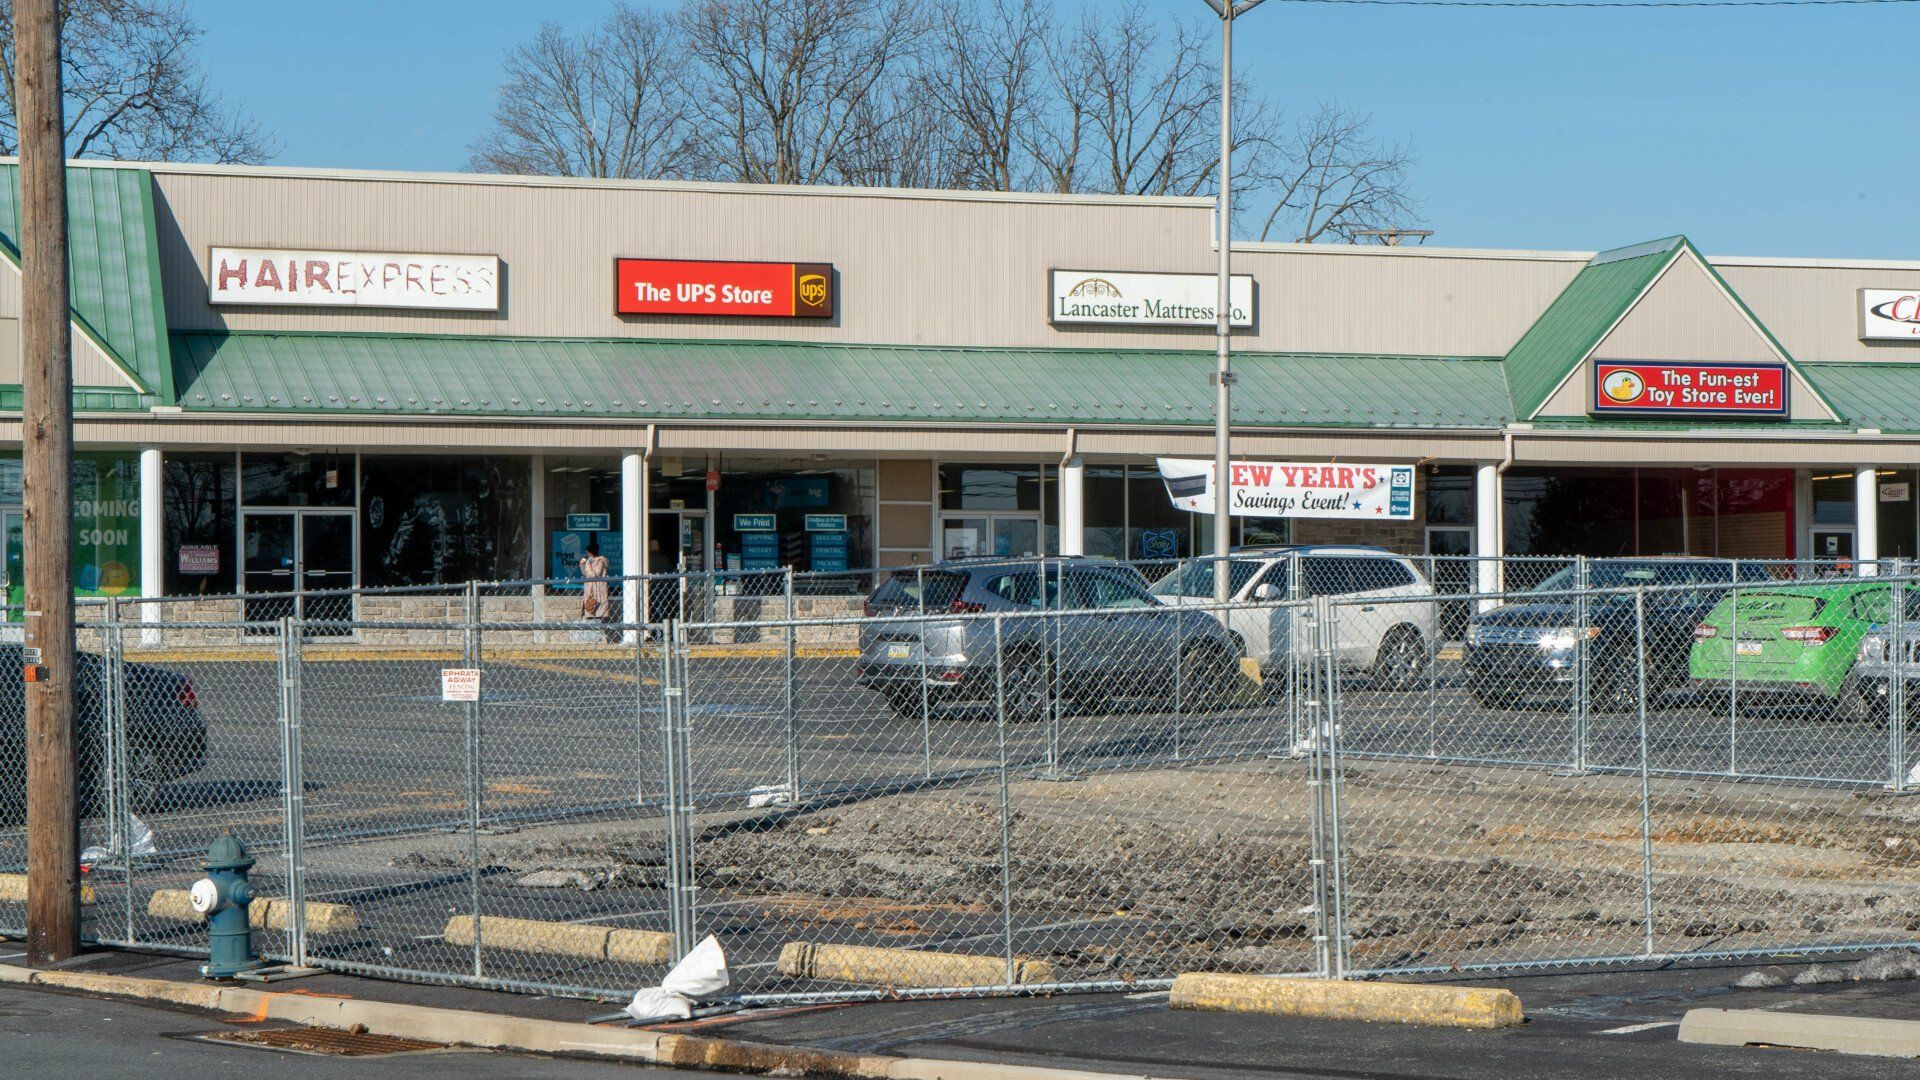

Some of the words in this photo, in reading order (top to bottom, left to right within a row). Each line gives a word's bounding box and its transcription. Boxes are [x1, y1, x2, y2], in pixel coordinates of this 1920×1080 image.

[634, 282, 671, 302] The
[676, 283, 717, 303] UPS
[721, 284, 773, 304] Store
[801, 284, 824, 300] ups
[1059, 297, 1140, 318] Lancaster
[1143, 299, 1215, 320] Mattress
[1228, 302, 1247, 321] o.
[1661, 370, 1692, 387] The
[1698, 371, 1760, 388] Fun-est
[1647, 386, 1676, 406] Toy
[1681, 388, 1727, 404] Store
[1734, 388, 1775, 405] Ever!
[1212, 464, 1273, 487] EW
[1280, 466, 1377, 490] YEAR'S
[1234, 489, 1296, 515] Savings
[1301, 491, 1350, 511] Event!
[739, 518, 752, 527] We
[753, 518, 770, 527] Print
[79, 529, 128, 546] SOON
[180, 553, 218, 564] WILLIAMS
[556, 552, 575, 560] Print
